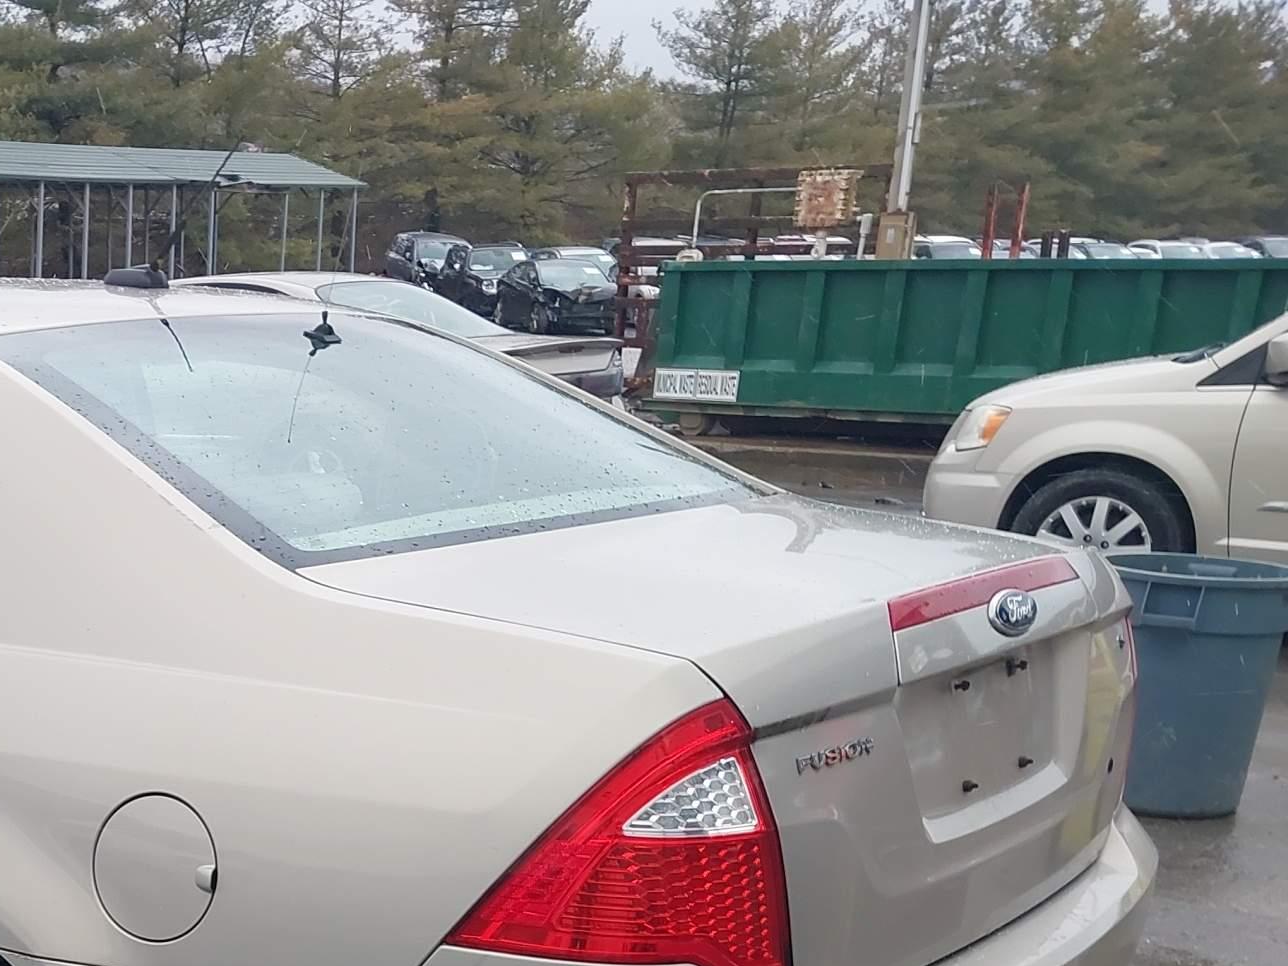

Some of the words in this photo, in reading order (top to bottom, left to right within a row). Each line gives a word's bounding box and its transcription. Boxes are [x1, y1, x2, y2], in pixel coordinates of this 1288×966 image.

[679, 374, 694, 395] WASTE
[720, 375, 737, 397] WASTE
[1006, 595, 1033, 623] Ford
[795, 737, 874, 776] FUSION
